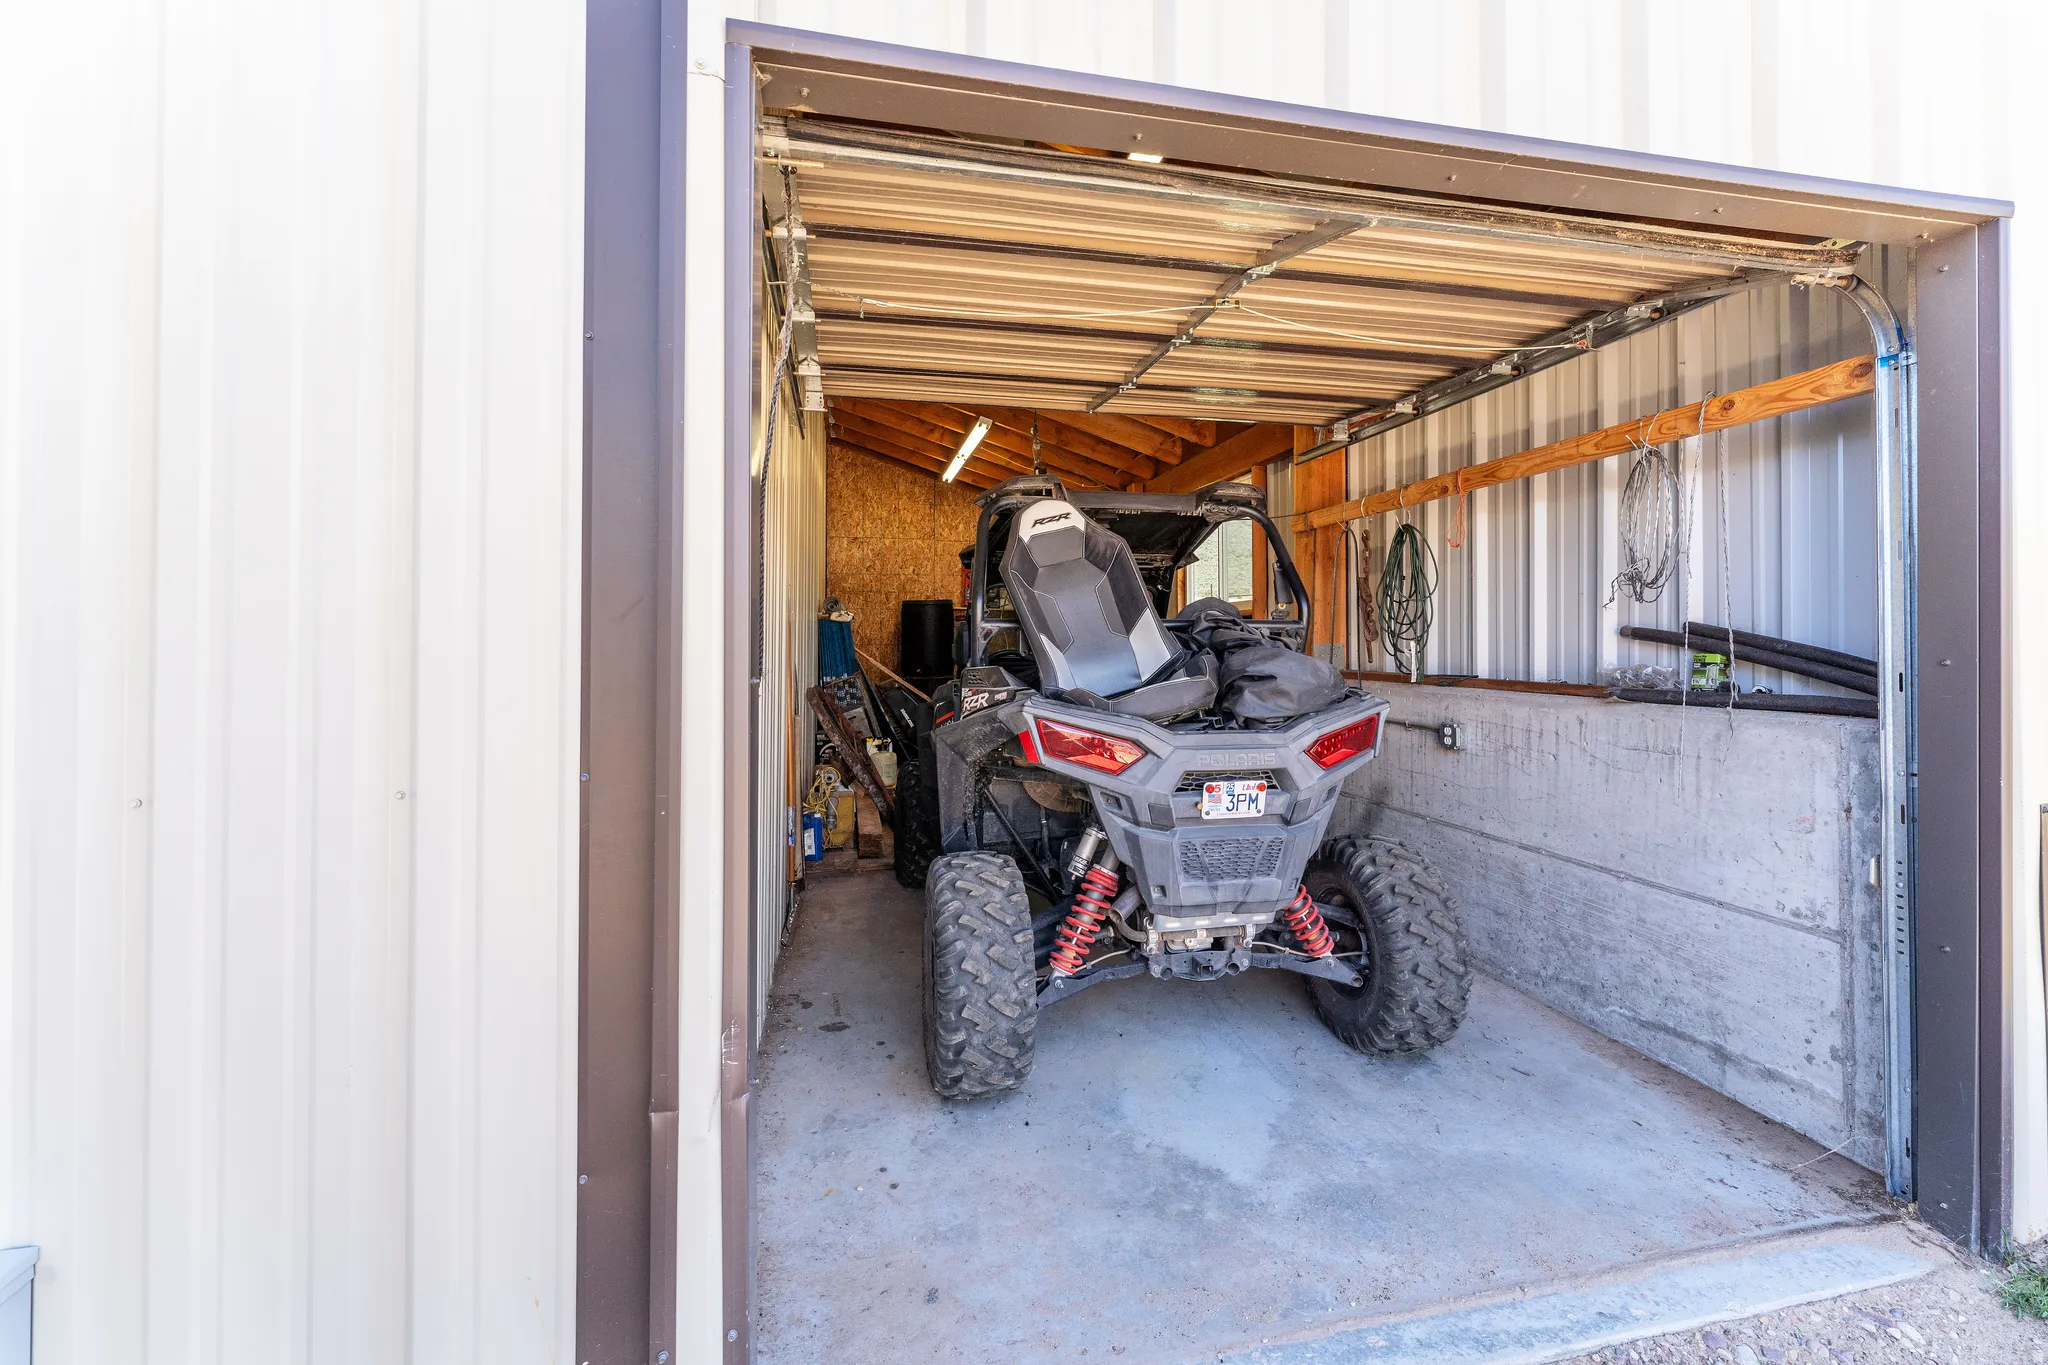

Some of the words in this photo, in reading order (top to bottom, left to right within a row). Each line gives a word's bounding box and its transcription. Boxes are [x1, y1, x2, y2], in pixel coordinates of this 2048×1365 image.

[1031, 512, 1072, 529] RZR
[963, 692, 989, 712] RZR
[1197, 752, 1276, 767] POLARIS
[1226, 793, 1259, 812] 3PM
